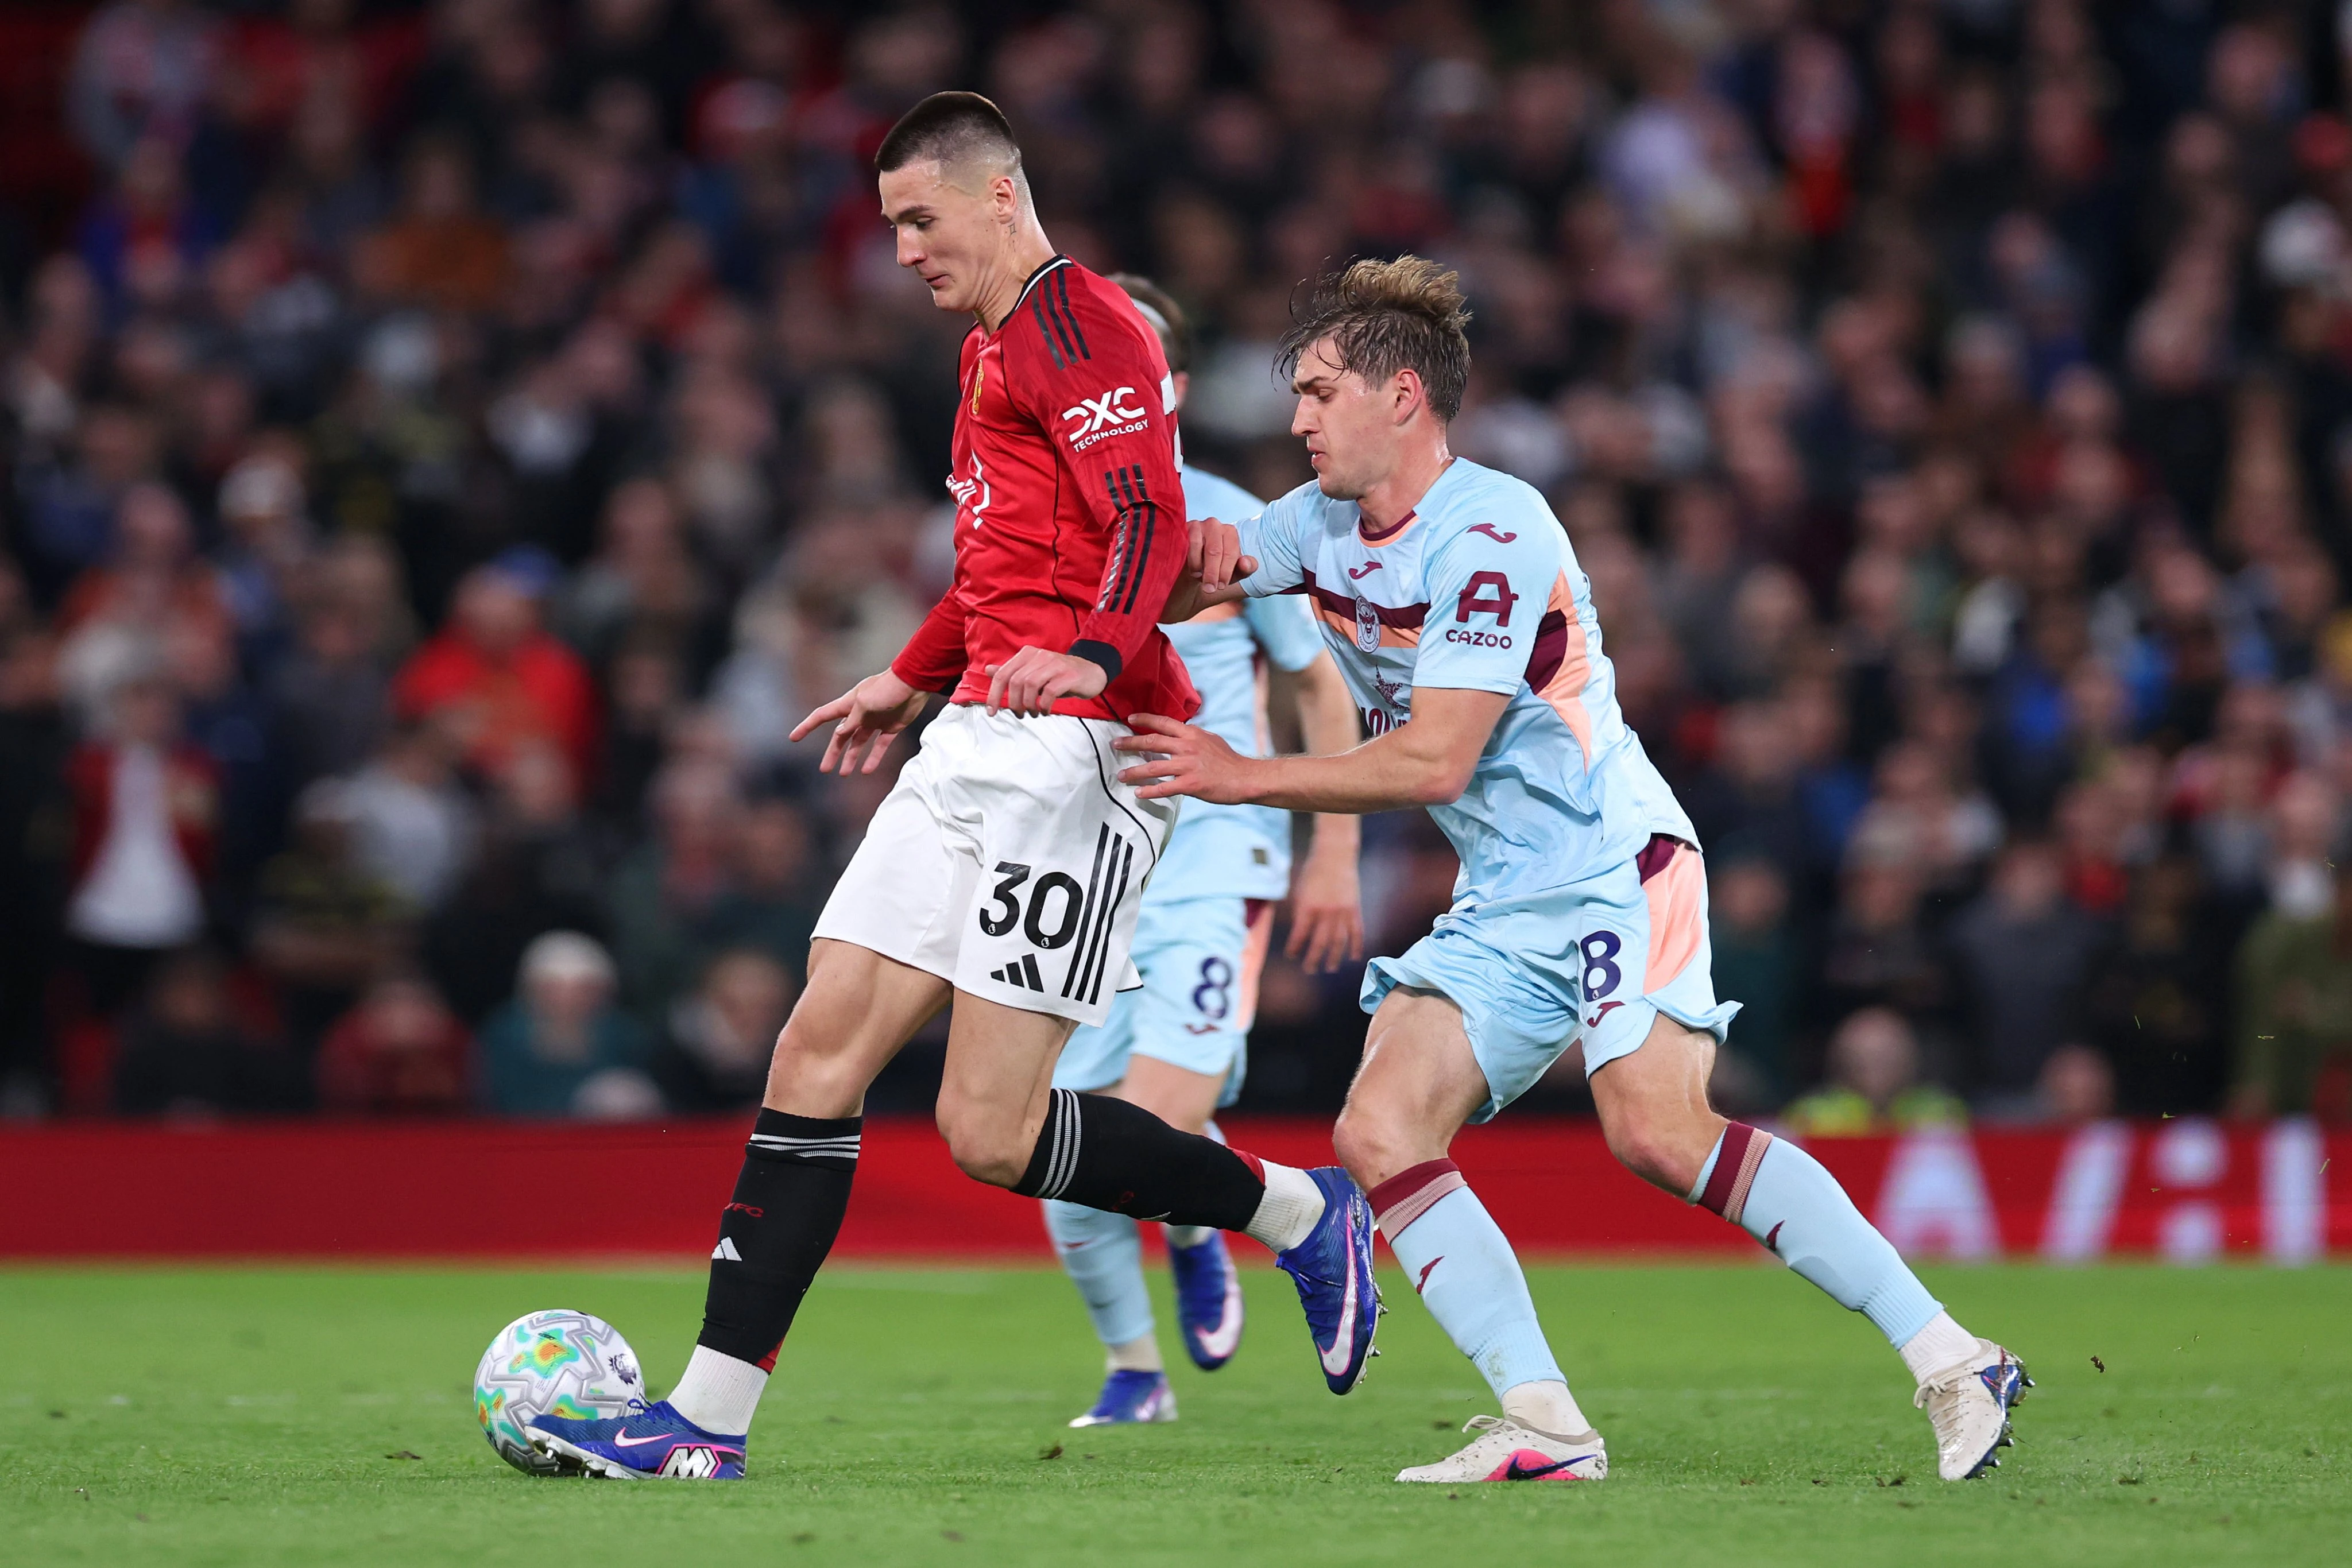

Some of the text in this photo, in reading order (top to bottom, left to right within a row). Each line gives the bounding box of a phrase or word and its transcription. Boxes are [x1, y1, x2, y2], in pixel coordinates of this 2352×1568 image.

[1062, 387, 1146, 442] DXC
[1073, 419, 1148, 452] TECHNOLOGY
[1446, 629, 1512, 649] CAZOO
[980, 861, 1083, 949] 30
[1193, 956, 1233, 1019] 8
[1580, 930, 1621, 1002] 8
[724, 1202, 764, 1217] FC
